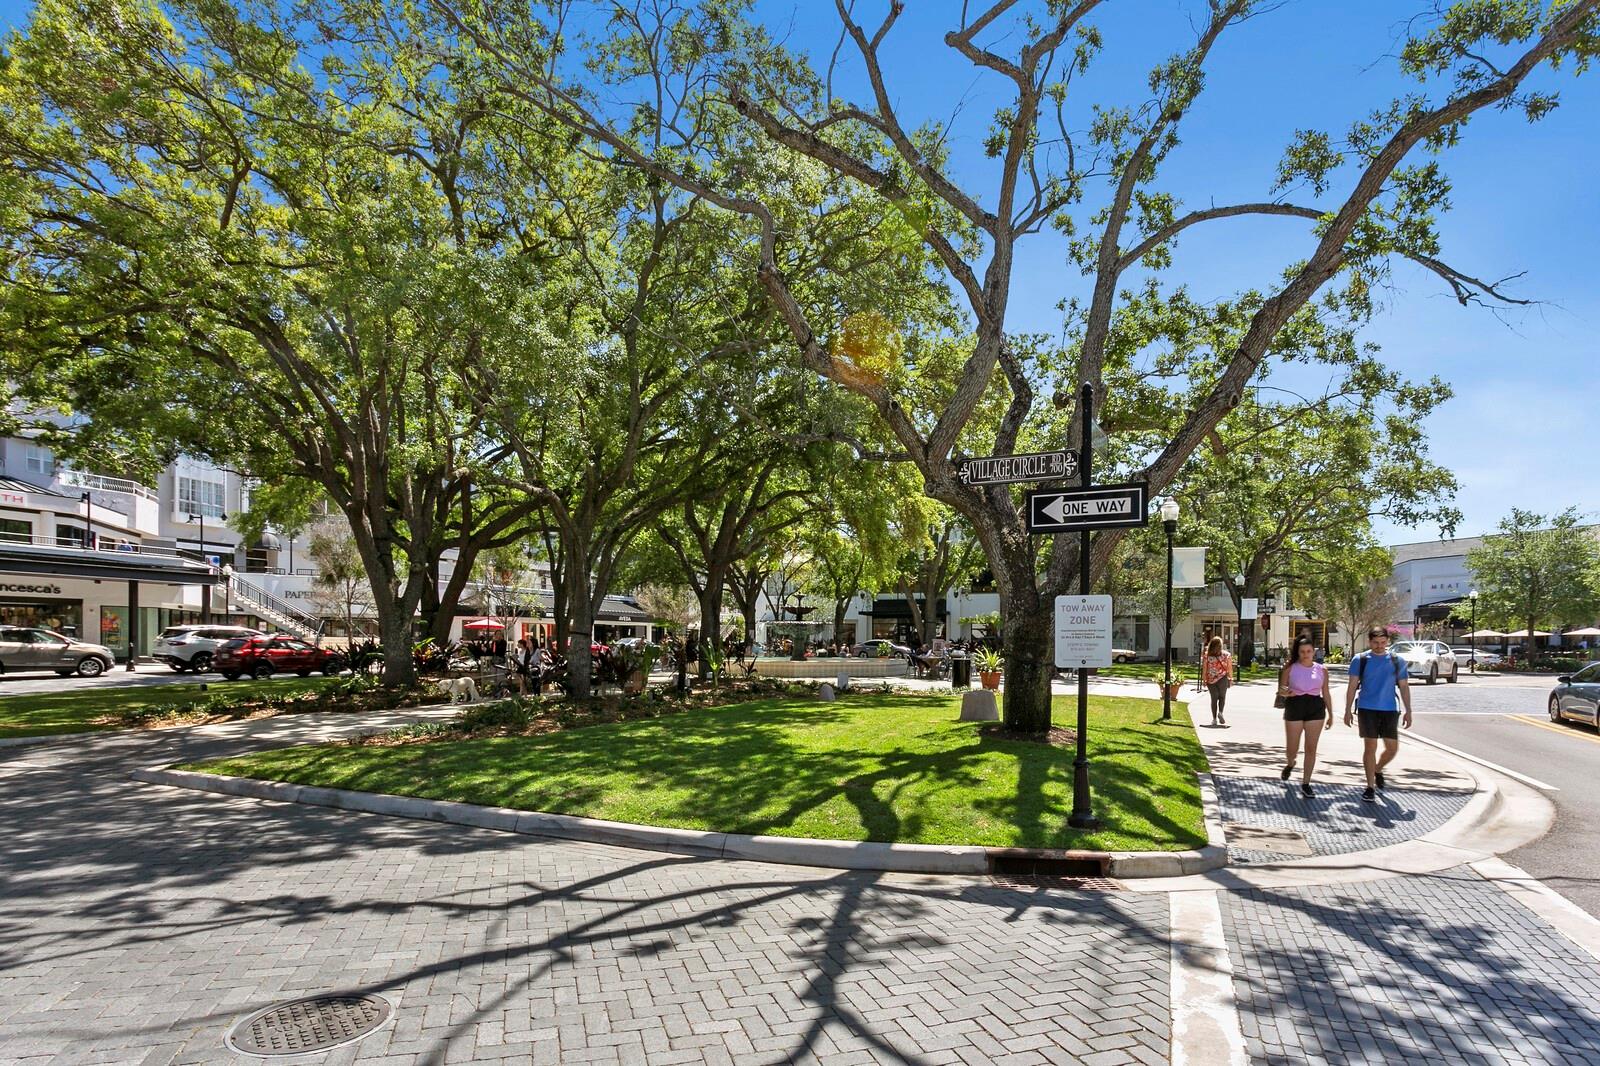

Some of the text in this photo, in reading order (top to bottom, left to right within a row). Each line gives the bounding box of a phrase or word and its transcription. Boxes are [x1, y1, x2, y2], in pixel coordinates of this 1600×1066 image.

[971, 459, 1011, 479] VILLAGE
[1012, 456, 1047, 476] CIRCLE
[1, 494, 23, 503] TH
[1063, 499, 1126, 516] ONE WAY
[0, 584, 61, 594] ncesca's
[1070, 616, 1096, 624] ZONE
